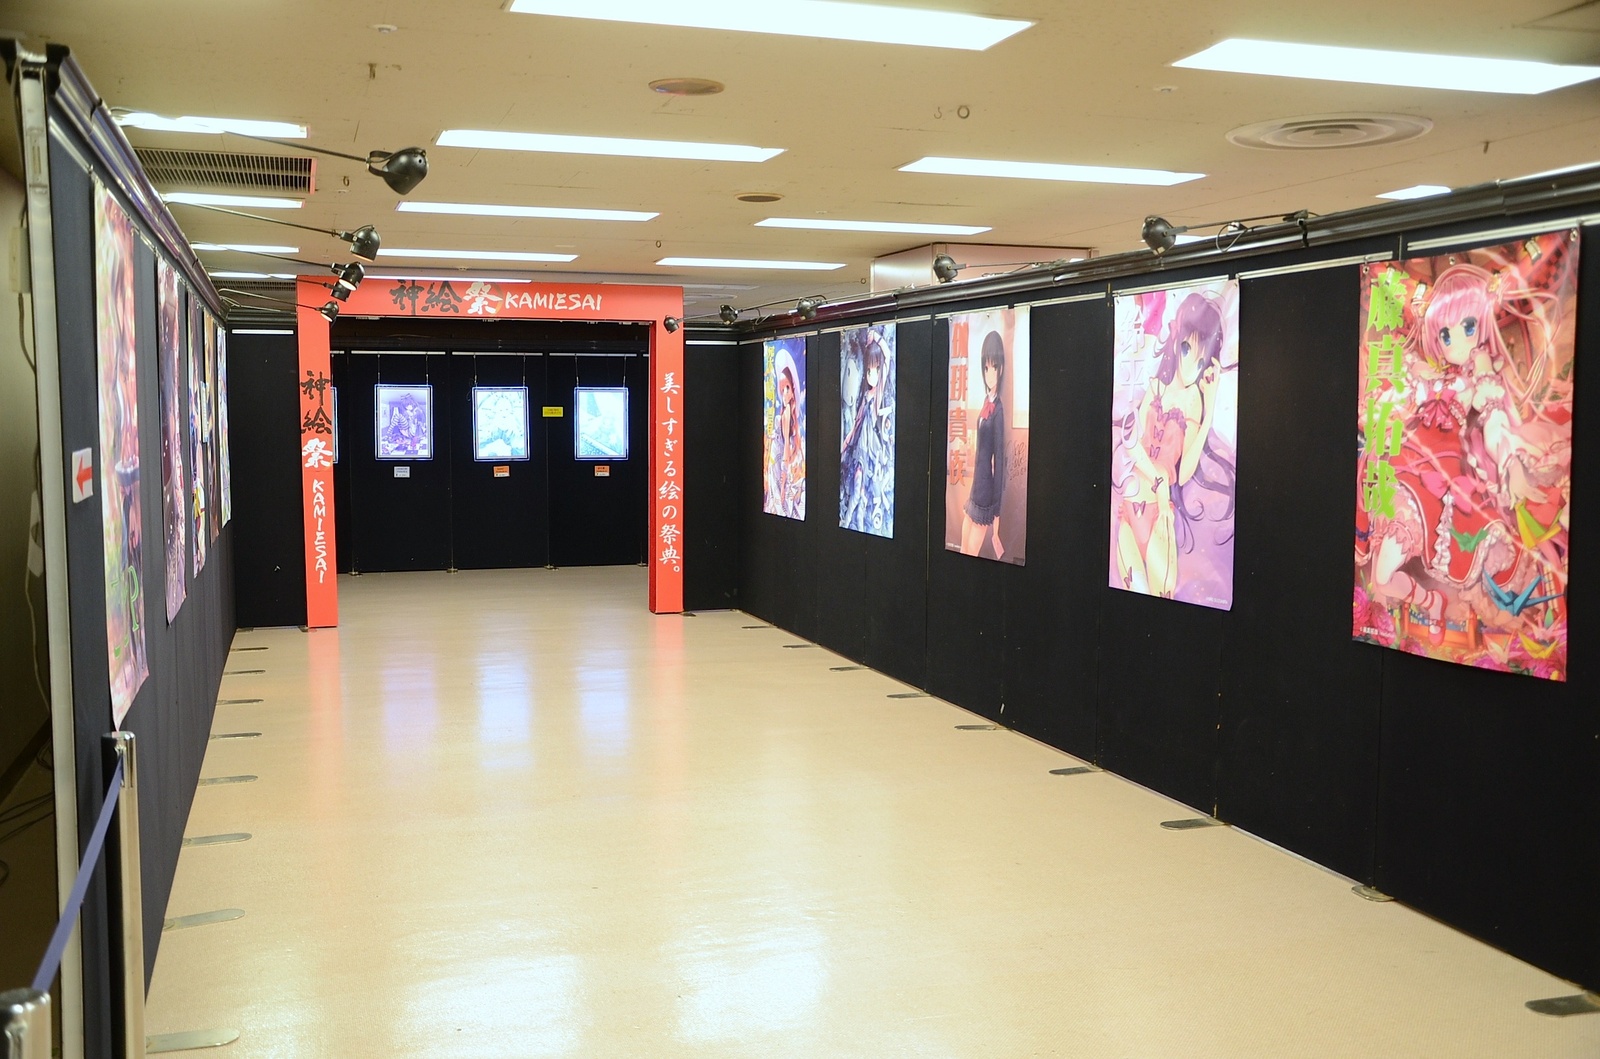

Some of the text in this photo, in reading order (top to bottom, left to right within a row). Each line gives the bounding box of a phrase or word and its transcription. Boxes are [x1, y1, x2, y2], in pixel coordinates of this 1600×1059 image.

[389, 279, 602, 315] 神絵祭 KAMIESAI
[300, 370, 333, 584] 神絵祭 KAMIESAI
[659, 371, 681, 573] 美しすぎる絵の祭典。
